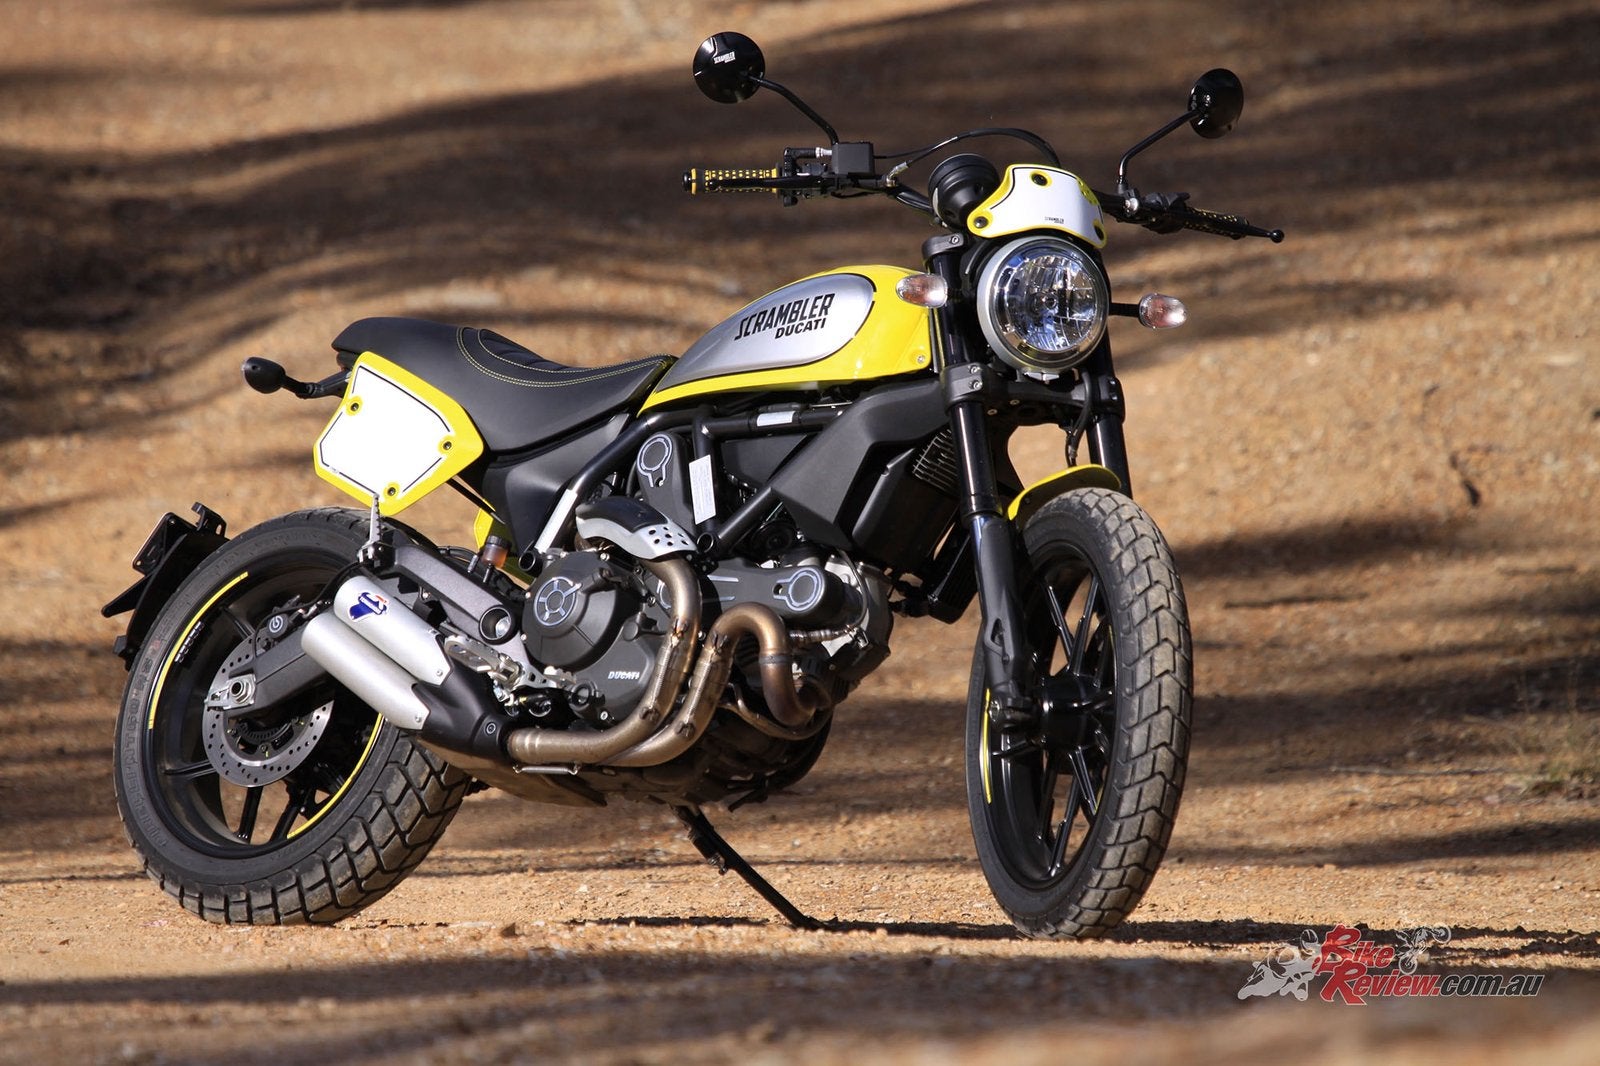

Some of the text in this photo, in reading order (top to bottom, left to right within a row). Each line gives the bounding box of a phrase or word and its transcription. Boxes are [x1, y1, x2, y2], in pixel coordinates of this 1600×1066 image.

[734, 293, 836, 341] SCRAMBLER
[774, 318, 827, 340] DUCATI
[607, 671, 640, 680] DUCATI
